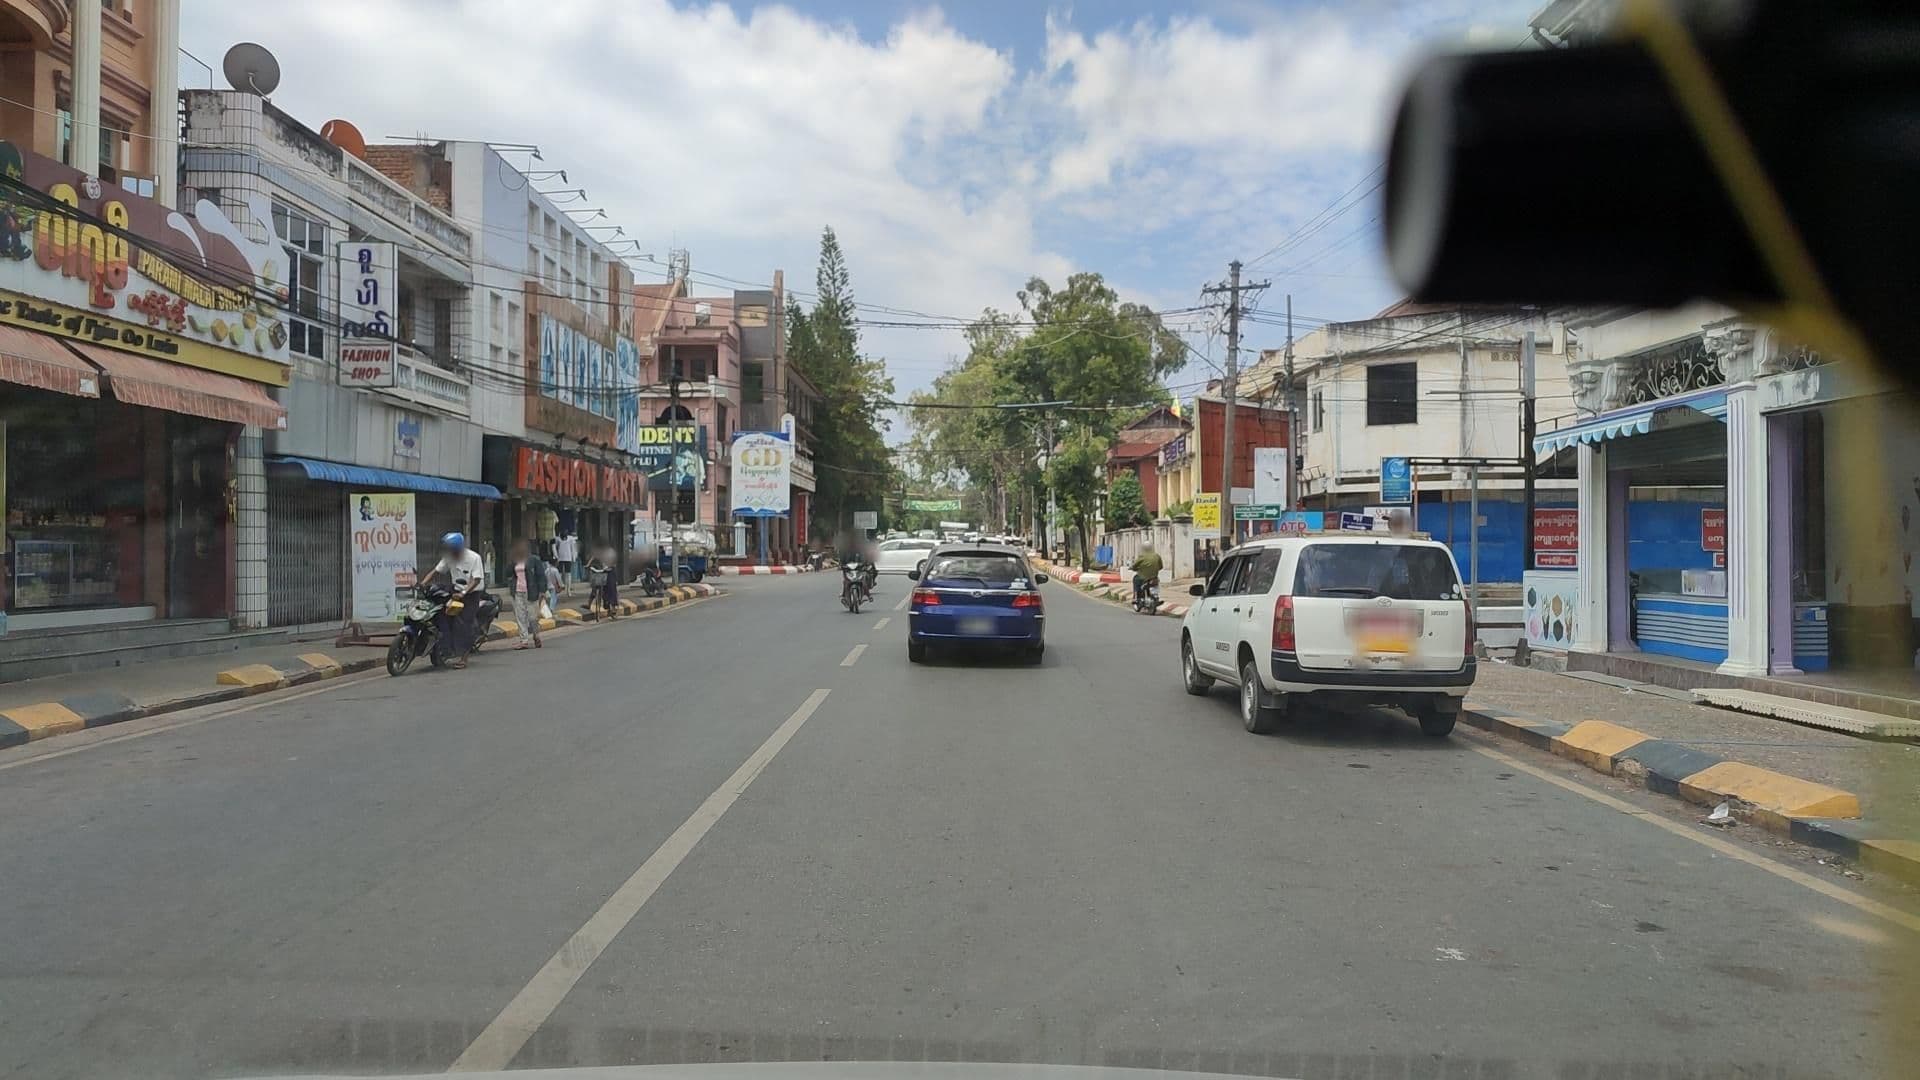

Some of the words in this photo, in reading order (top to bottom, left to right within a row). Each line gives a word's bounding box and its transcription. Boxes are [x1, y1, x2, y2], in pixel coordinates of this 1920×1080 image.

[15, 301, 62, 327] Taste
[64, 315, 85, 335] of
[85, 318, 118, 341] Pyin
[121, 328, 144, 347] Oo
[146, 334, 179, 355] Lwin
[342, 349, 391, 362] FASHION
[351, 367, 381, 380] SHOP
[517, 446, 597, 502] FASHION
[603, 464, 648, 505] PARTY
